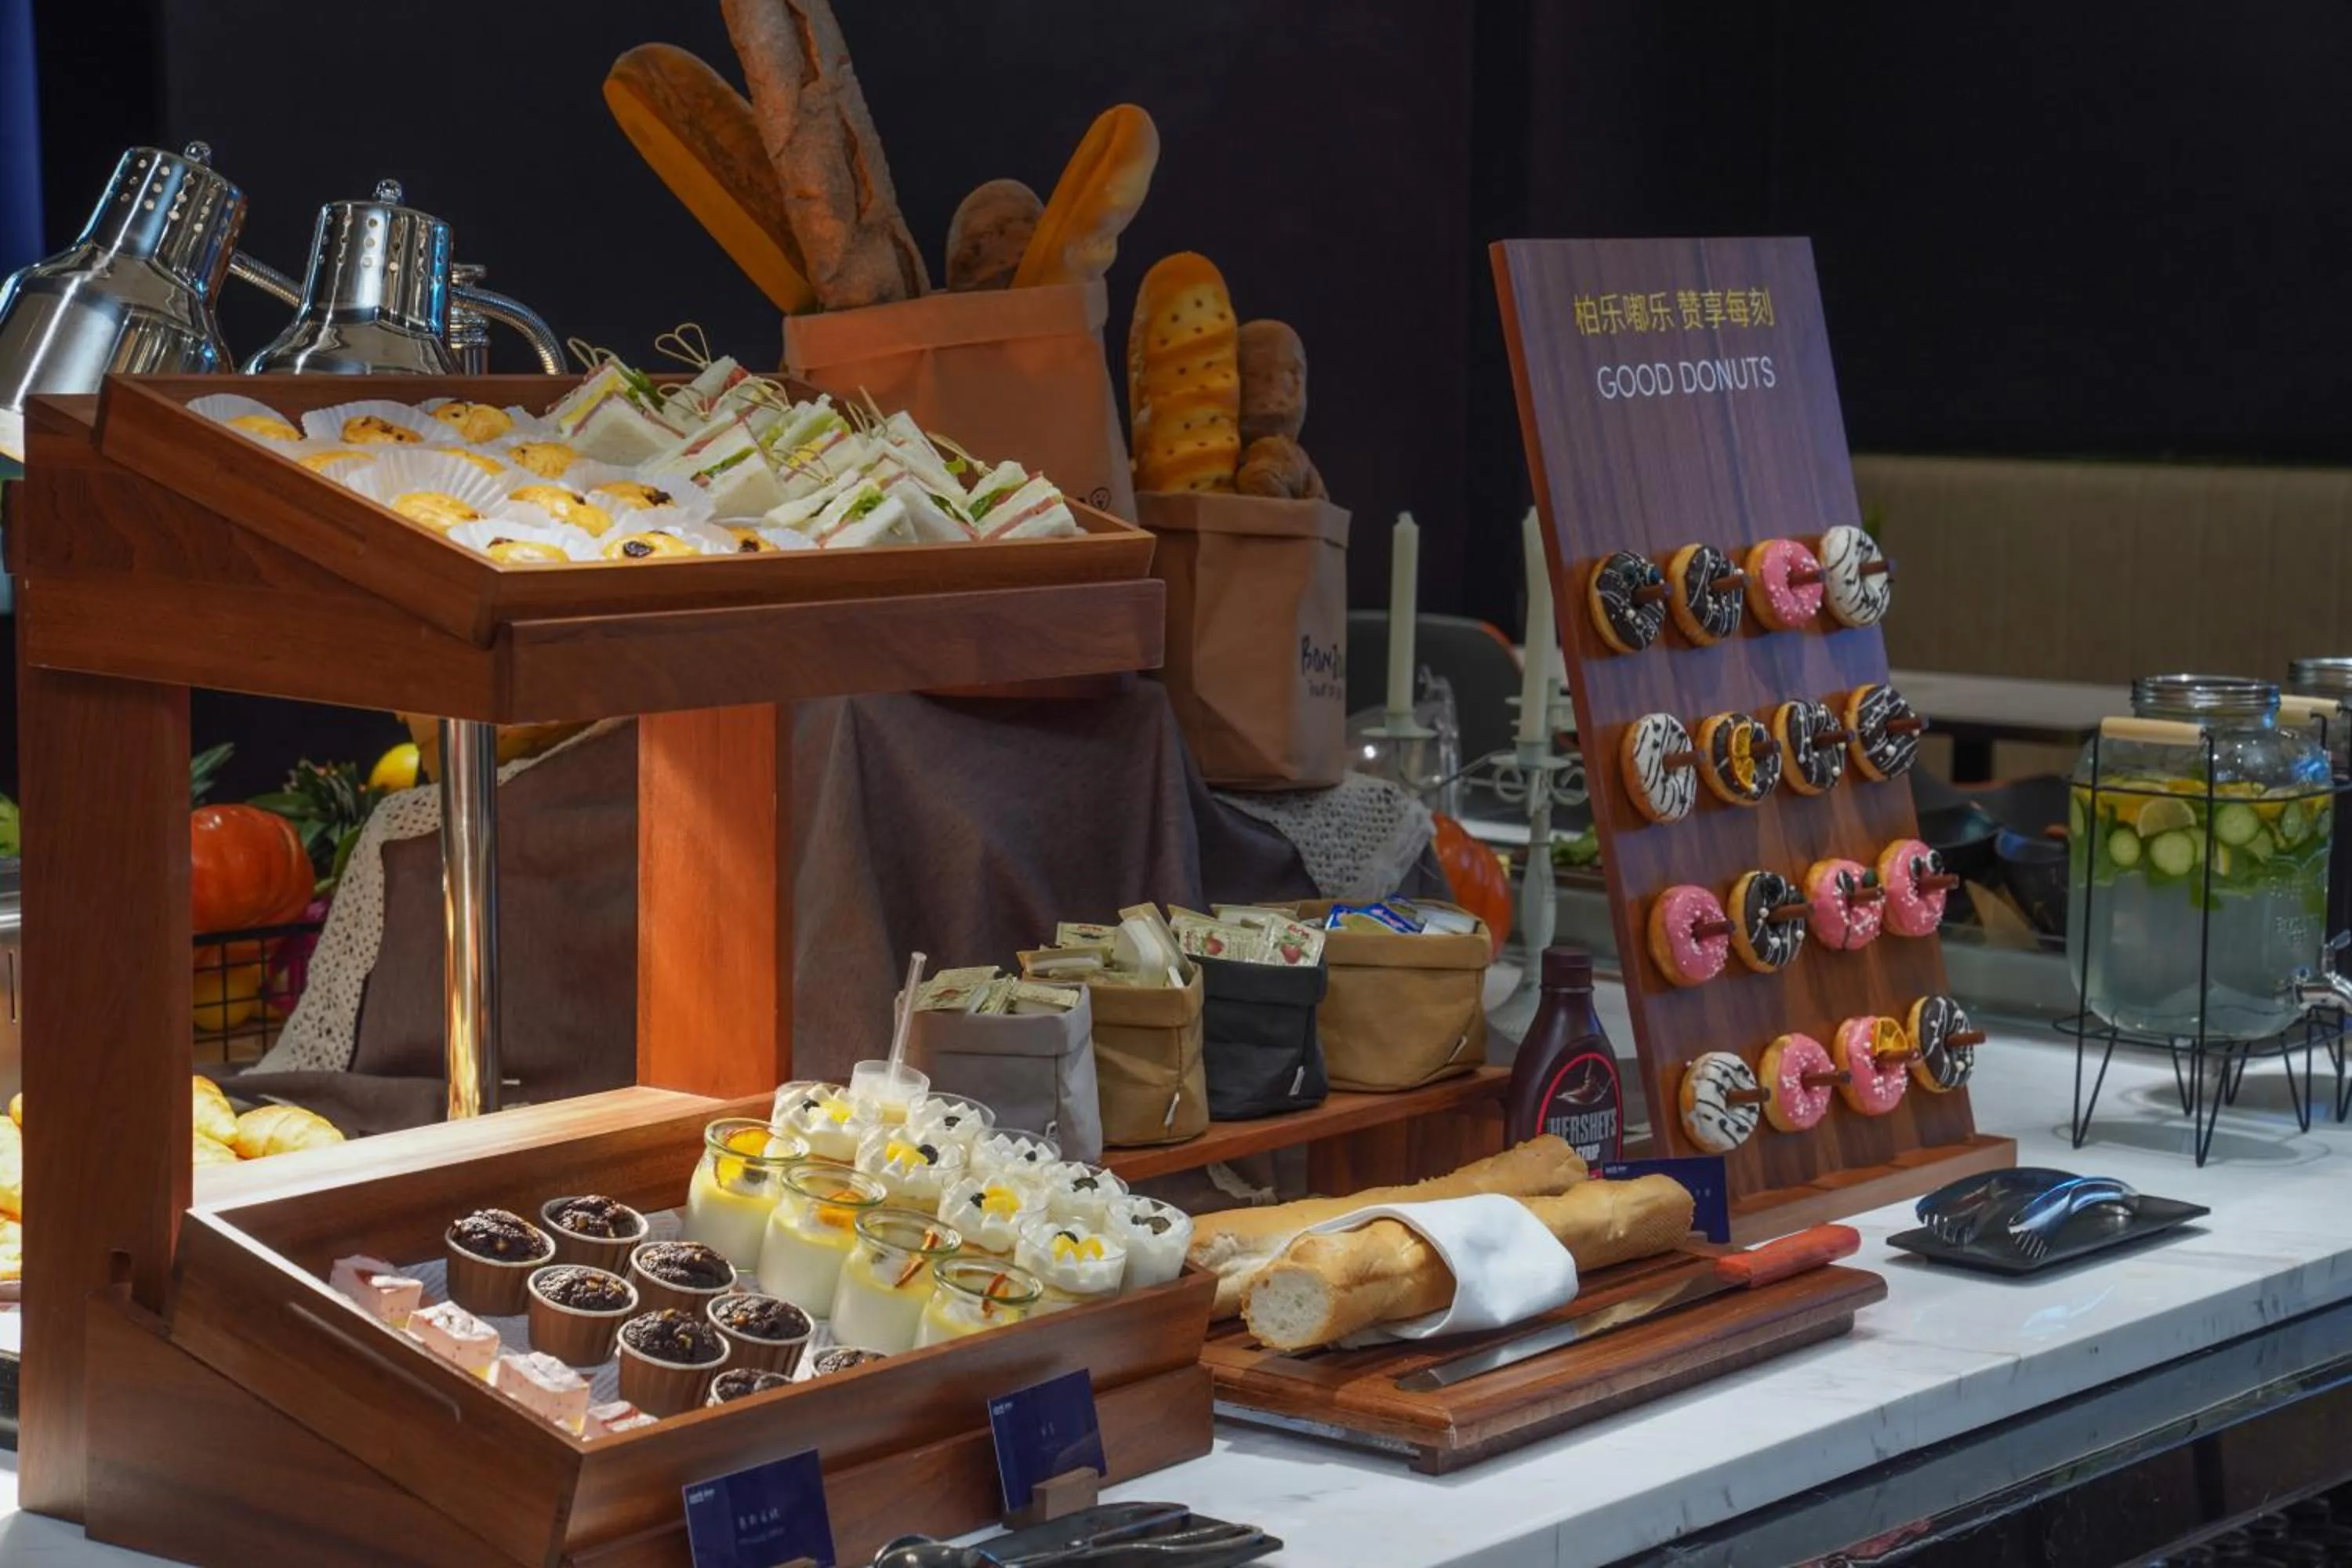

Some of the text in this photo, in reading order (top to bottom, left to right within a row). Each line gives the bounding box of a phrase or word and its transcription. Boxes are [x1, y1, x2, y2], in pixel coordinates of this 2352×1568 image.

[1574, 286, 1775, 336] 柏乐嘟乐 赞享每刻
[1597, 355, 1776, 399] GOOD DONUTS
[1548, 1107, 1617, 1145] HERSHEY'S
